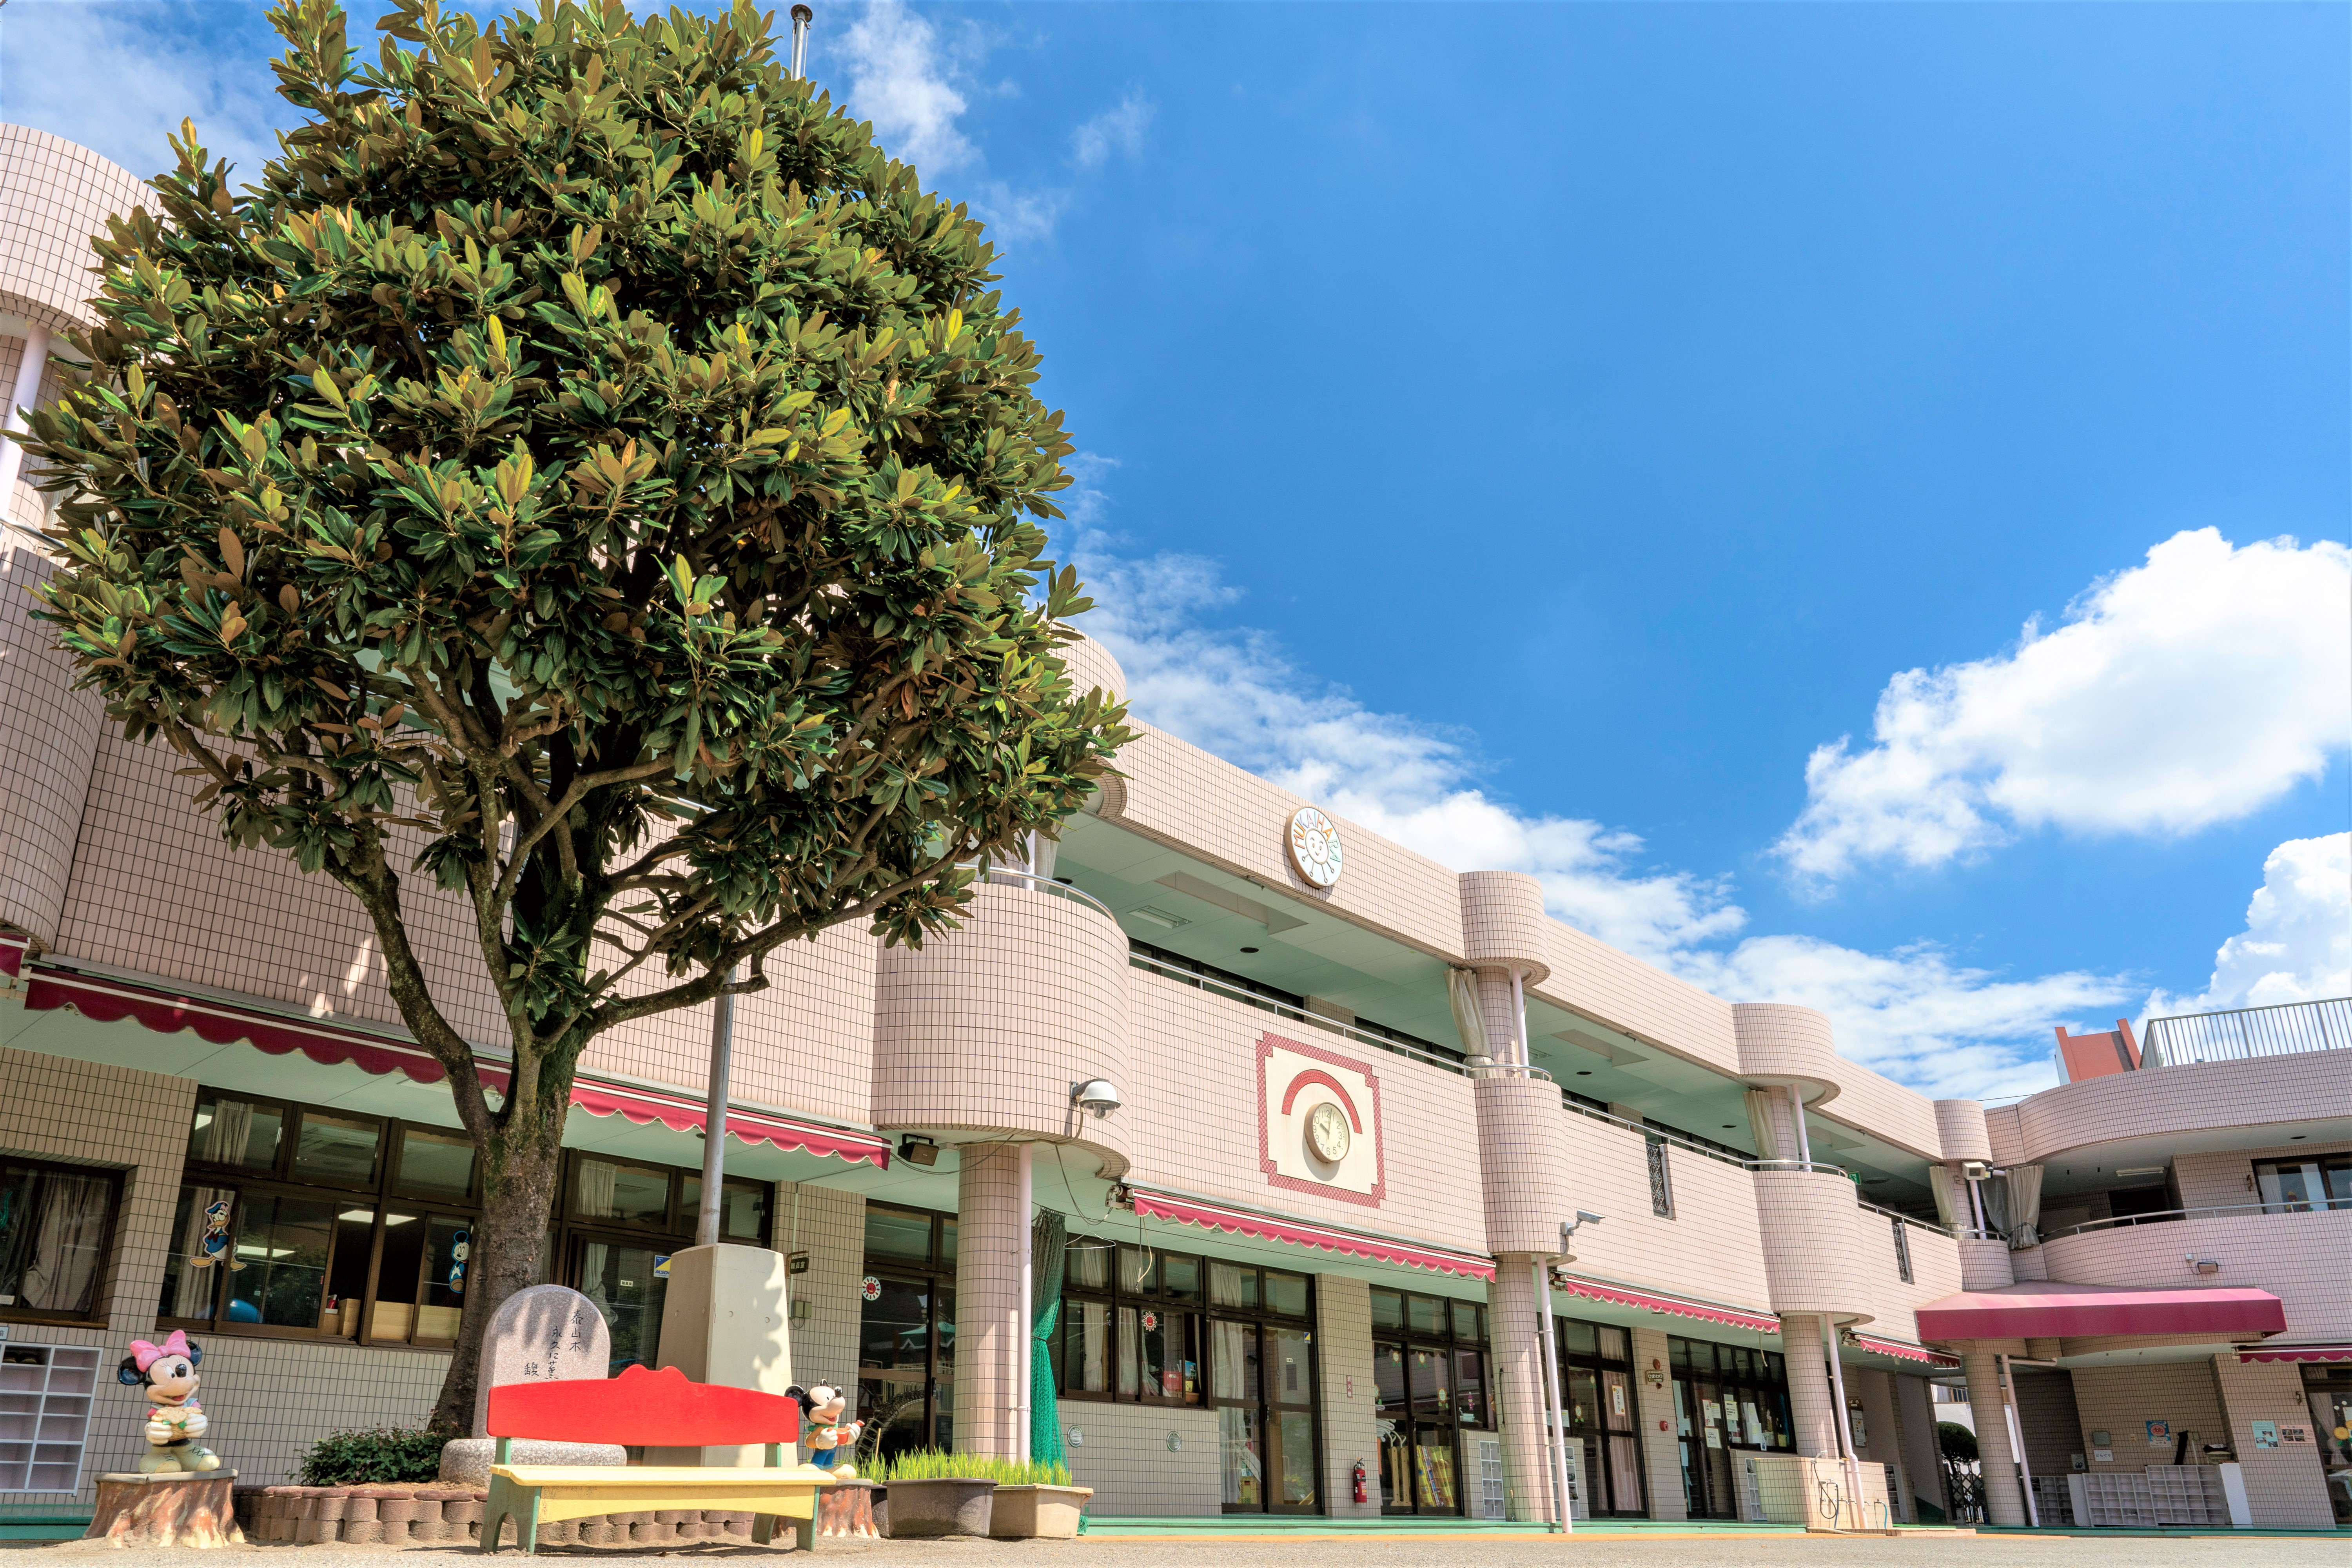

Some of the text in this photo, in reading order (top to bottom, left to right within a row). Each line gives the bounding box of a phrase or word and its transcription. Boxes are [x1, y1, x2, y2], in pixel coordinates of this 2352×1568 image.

[1294, 810, 1341, 862] MUKAIHARA
[1319, 1109, 1323, 1118] 11
[1324, 1109, 1330, 1118] 12
[1314, 1116, 1319, 1124] 10
[1336, 1121, 1340, 1129] 2
[1315, 1134, 1319, 1143] 8
[1338, 1131, 1343, 1140] 3
[1320, 1143, 1325, 1151] 7
[1326, 1147, 1330, 1156] 6
[1332, 1146, 1337, 1154] 5
[569, 1309, 583, 1352] 泰山木
